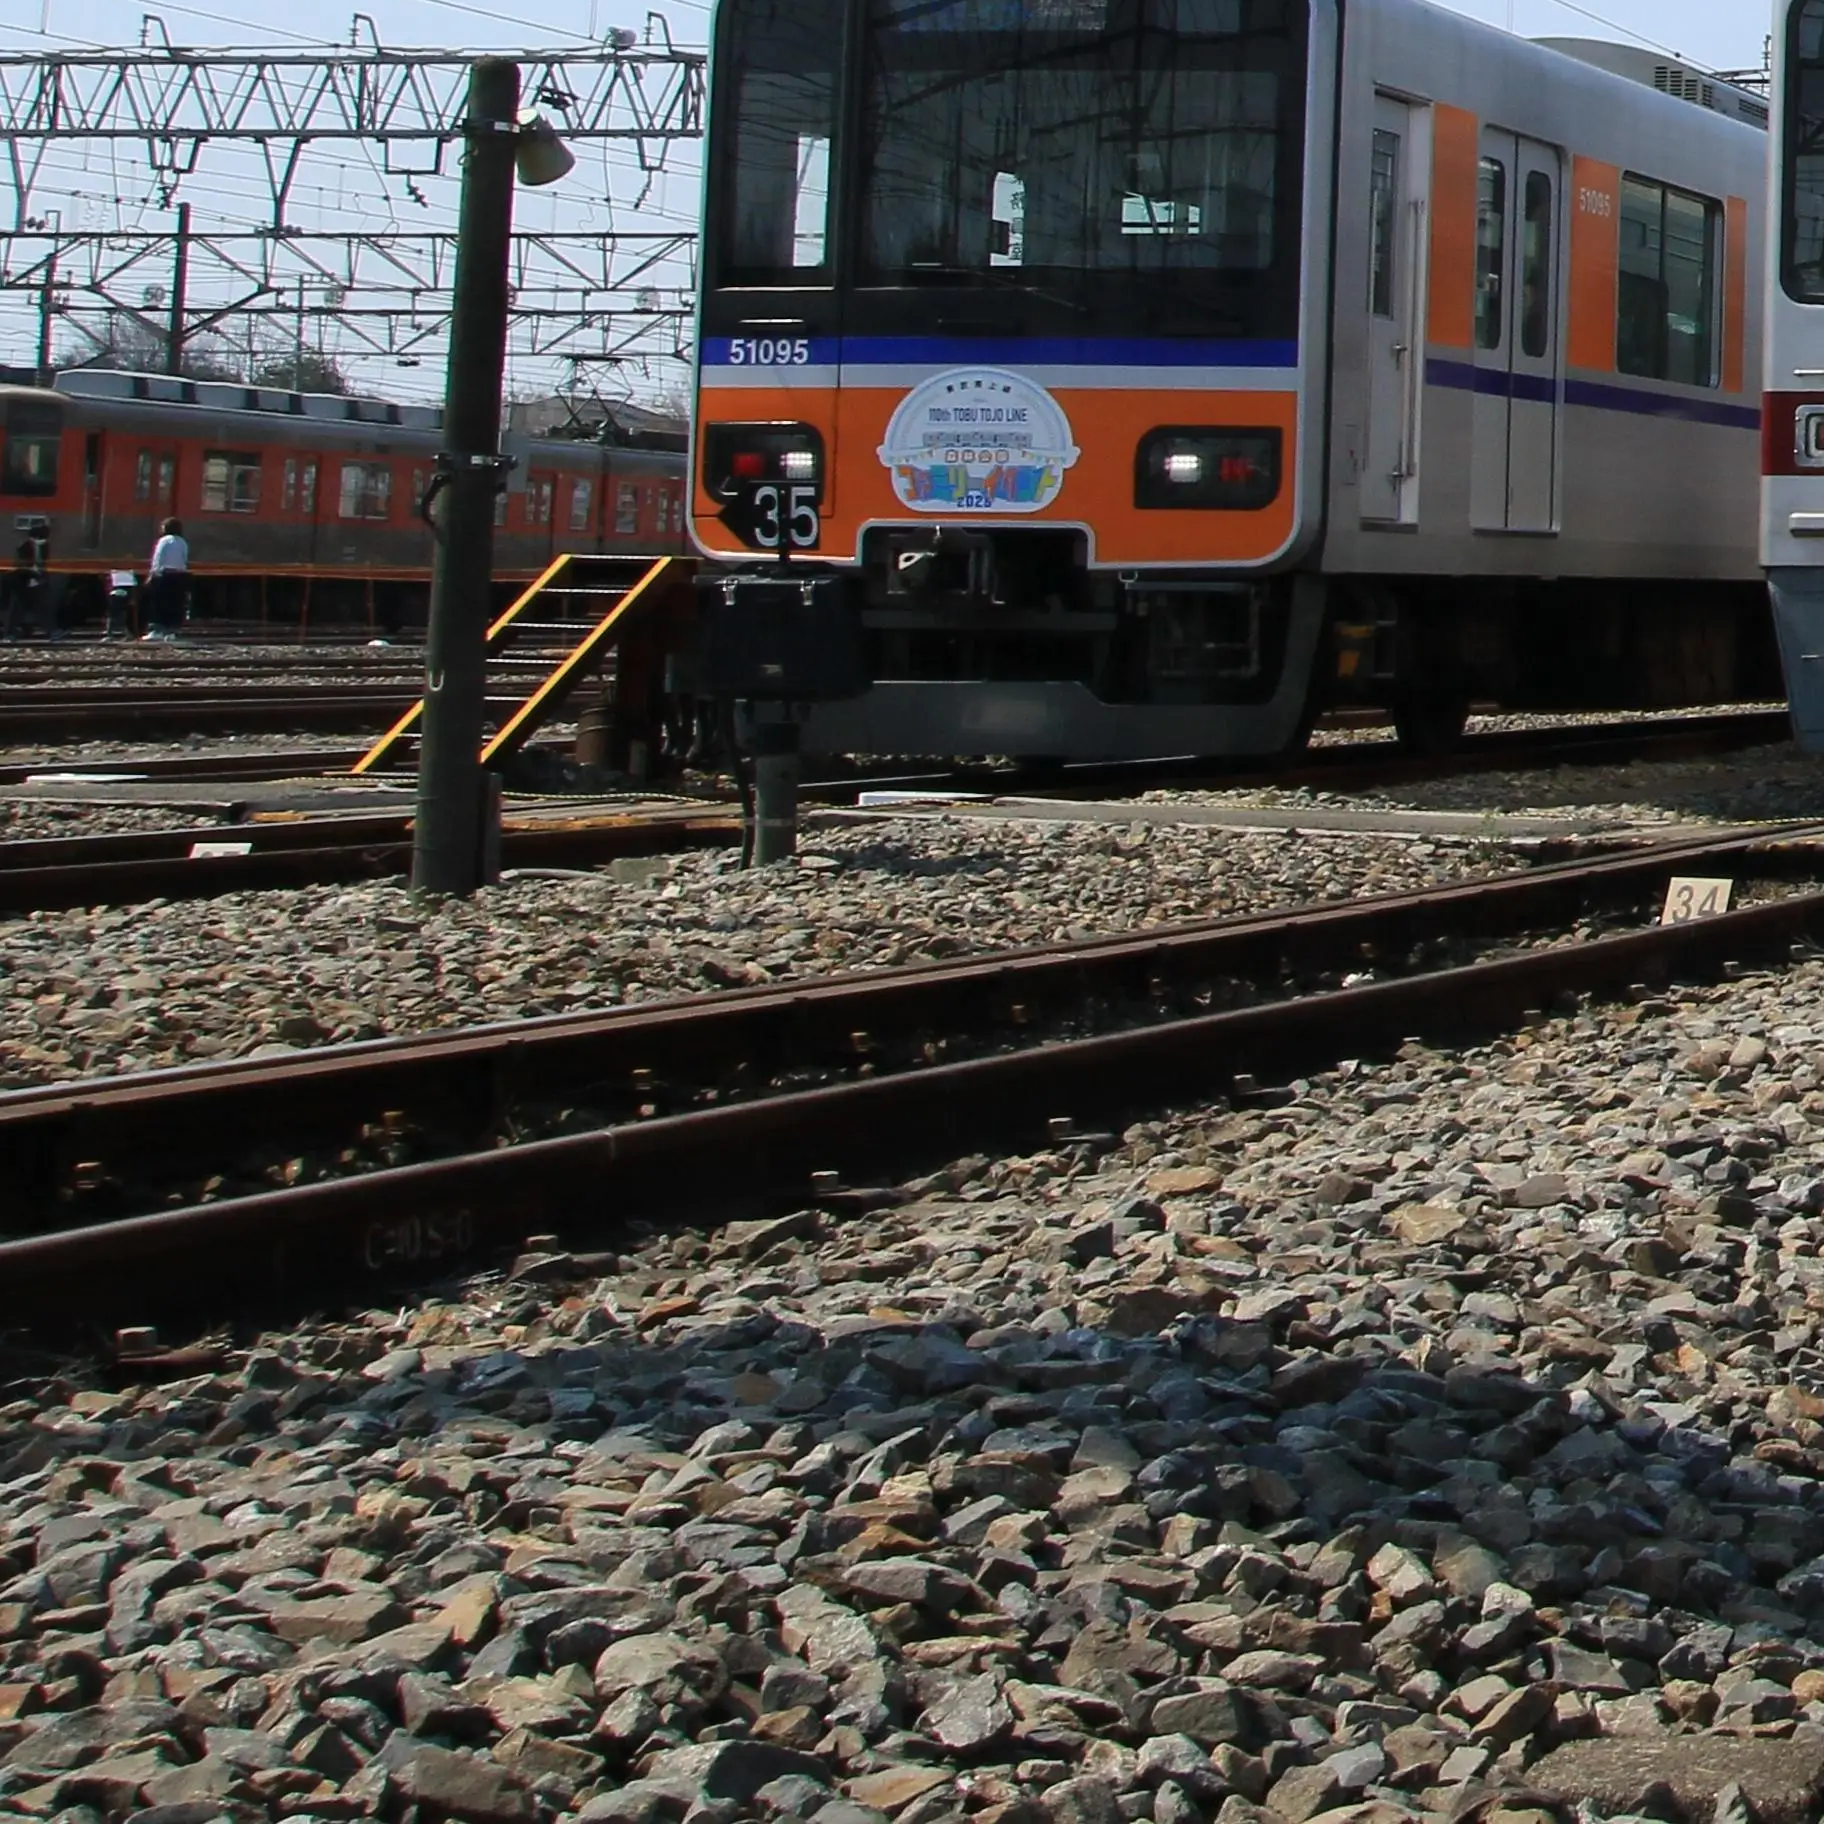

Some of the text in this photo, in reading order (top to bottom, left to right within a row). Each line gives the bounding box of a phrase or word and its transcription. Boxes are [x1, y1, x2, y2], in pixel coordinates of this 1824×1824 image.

[1579, 187, 1611, 217] 51095
[730, 339, 809, 364] 51095
[954, 408, 977, 421] TOBU
[980, 408, 1003, 421] TOJO
[1006, 408, 1028, 421] LINE
[755, 486, 818, 547] 35
[1672, 884, 1719, 923] 34
